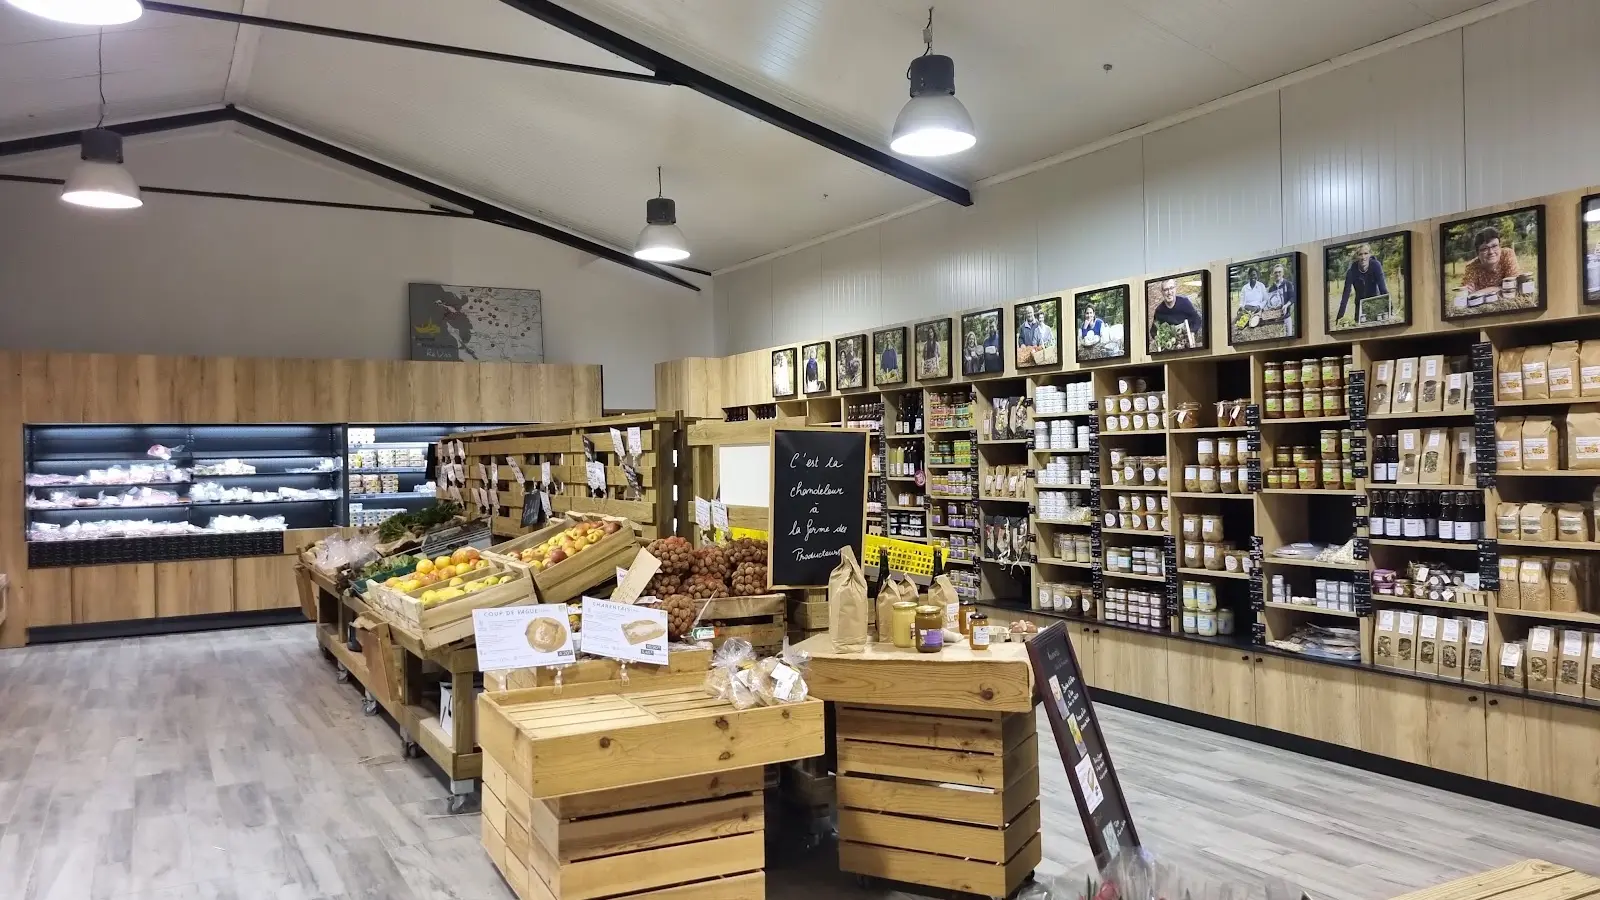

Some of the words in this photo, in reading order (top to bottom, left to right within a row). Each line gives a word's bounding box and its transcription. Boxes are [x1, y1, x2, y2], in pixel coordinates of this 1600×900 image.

[790, 452, 819, 468] C'est
[825, 456, 843, 468] la
[790, 481, 844, 497] chandeleur
[788, 520, 801, 535] la
[592, 602, 631, 612] CHARENTAIS
